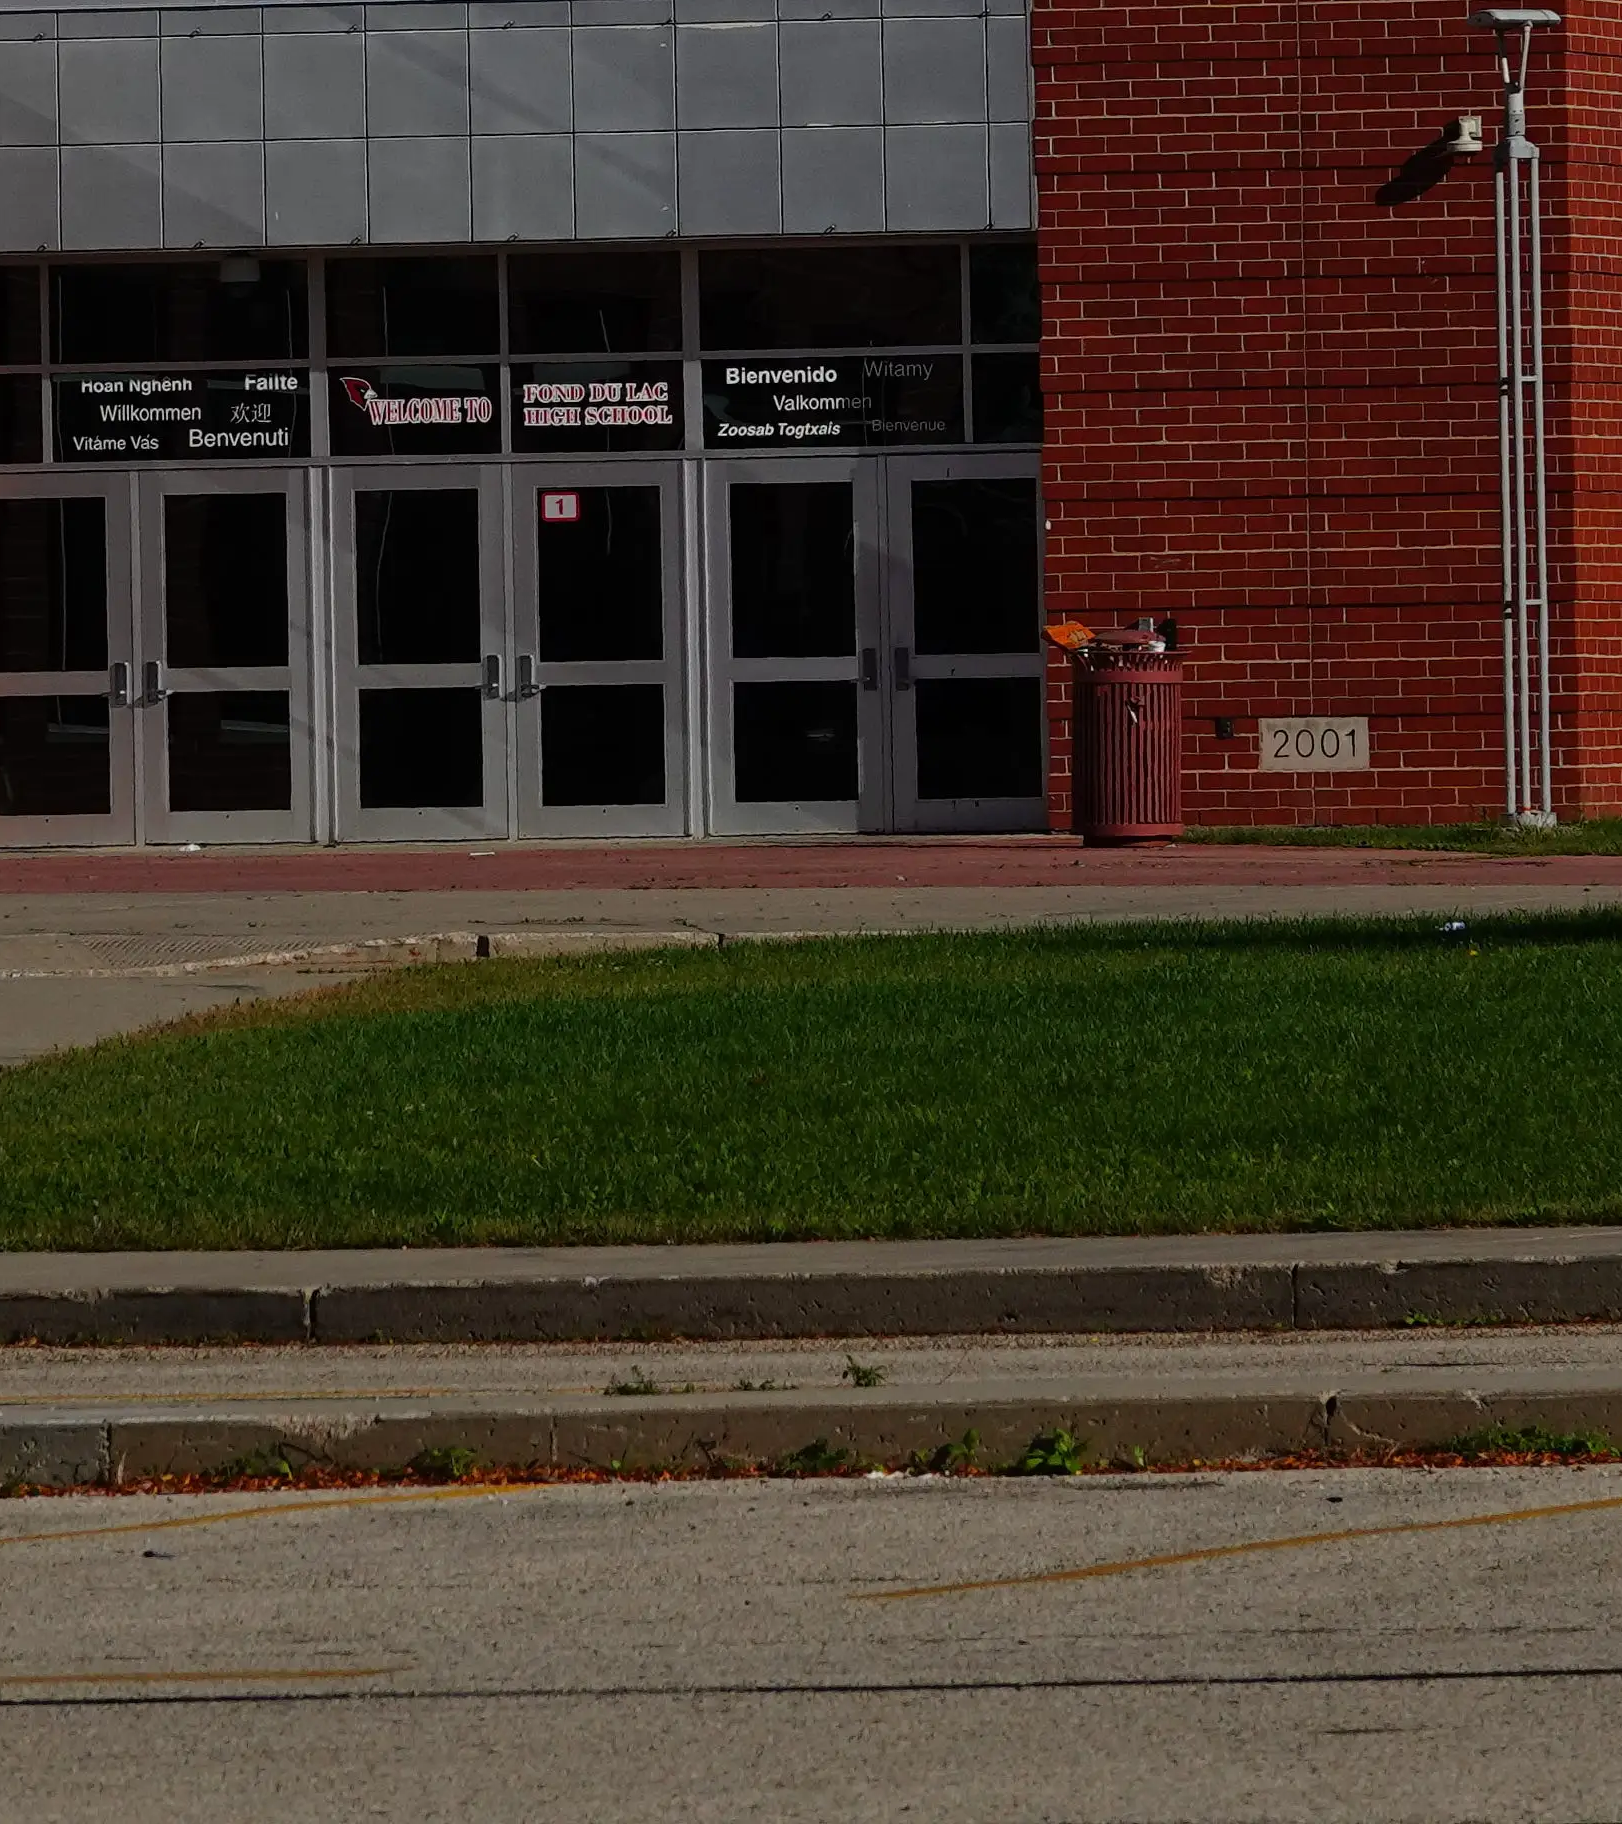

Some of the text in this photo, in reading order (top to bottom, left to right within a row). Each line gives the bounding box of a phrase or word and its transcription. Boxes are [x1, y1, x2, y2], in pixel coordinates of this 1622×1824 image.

[725, 366, 838, 385] Bienvenido
[863, 359, 934, 381] Witamy
[81, 376, 193, 397] Hoan Nghênh
[244, 374, 298, 392] Failte
[522, 382, 668, 404] FOND DU LAC
[99, 403, 202, 423] Willkommen
[230, 402, 272, 424] 欢迎
[367, 397, 492, 426] WELCOME TO
[773, 394, 872, 412] Valkommen
[523, 404, 673, 426] HIGH SCHOOL
[717, 421, 841, 440] Zoosab Togtxais
[871, 418, 946, 433] Bienvenue
[130, 433, 159, 450] Vás
[188, 428, 289, 448] Benvenuti
[555, 499, 563, 515] 1
[1273, 728, 1356, 758] 2001
